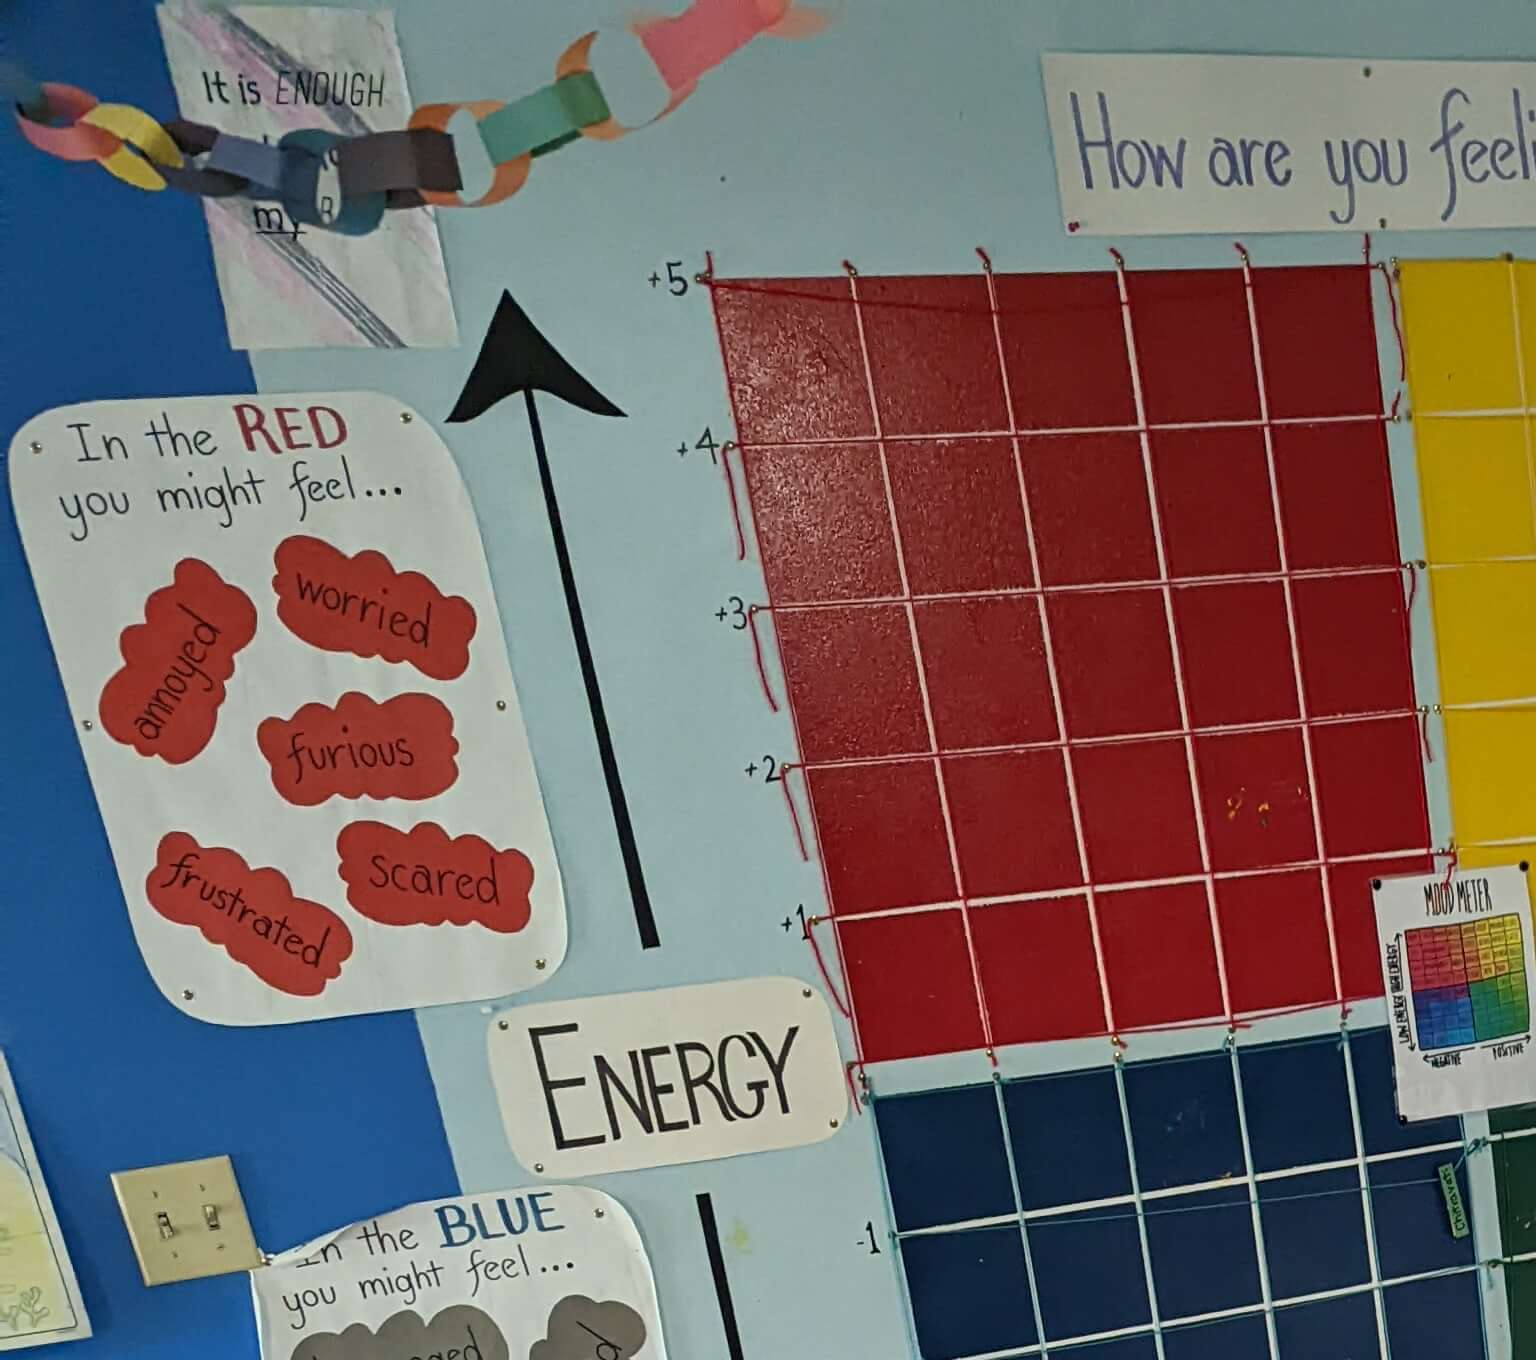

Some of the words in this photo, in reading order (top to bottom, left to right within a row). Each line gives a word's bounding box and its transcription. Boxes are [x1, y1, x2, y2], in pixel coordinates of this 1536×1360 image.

[203, 71, 230, 103] It
[238, 74, 261, 104] is
[276, 71, 384, 106] ENOUGH
[1070, 91, 1186, 189] How
[1208, 137, 1292, 187] are
[1324, 138, 1408, 224] you
[649, 262, 689, 296] +5
[67, 422, 127, 463] In
[145, 412, 218, 460] the
[231, 403, 349, 454] RED
[678, 433, 719, 466] +4
[59, 488, 130, 541] you
[156, 468, 265, 528] might
[289, 455, 403, 521] feel...
[297, 571, 432, 648] worried
[715, 597, 747, 630] +3
[135, 603, 221, 740] annoyed
[288, 725, 415, 784] furious
[744, 755, 781, 783] +2
[369, 854, 502, 907] scared
[1424, 882, 1454, 917] MOOD
[1457, 878, 1493, 913] METER
[160, 853, 332, 970] frustrated
[781, 903, 811, 941] +1
[529, 1023, 799, 1150] ENERGY
[357, 1221, 419, 1257] the
[434, 1192, 566, 1249] BLUE
[857, 1221, 881, 1254] -1
[283, 1286, 337, 1329] you
[359, 1261, 443, 1305] might
[466, 1246, 575, 1297] feel...
